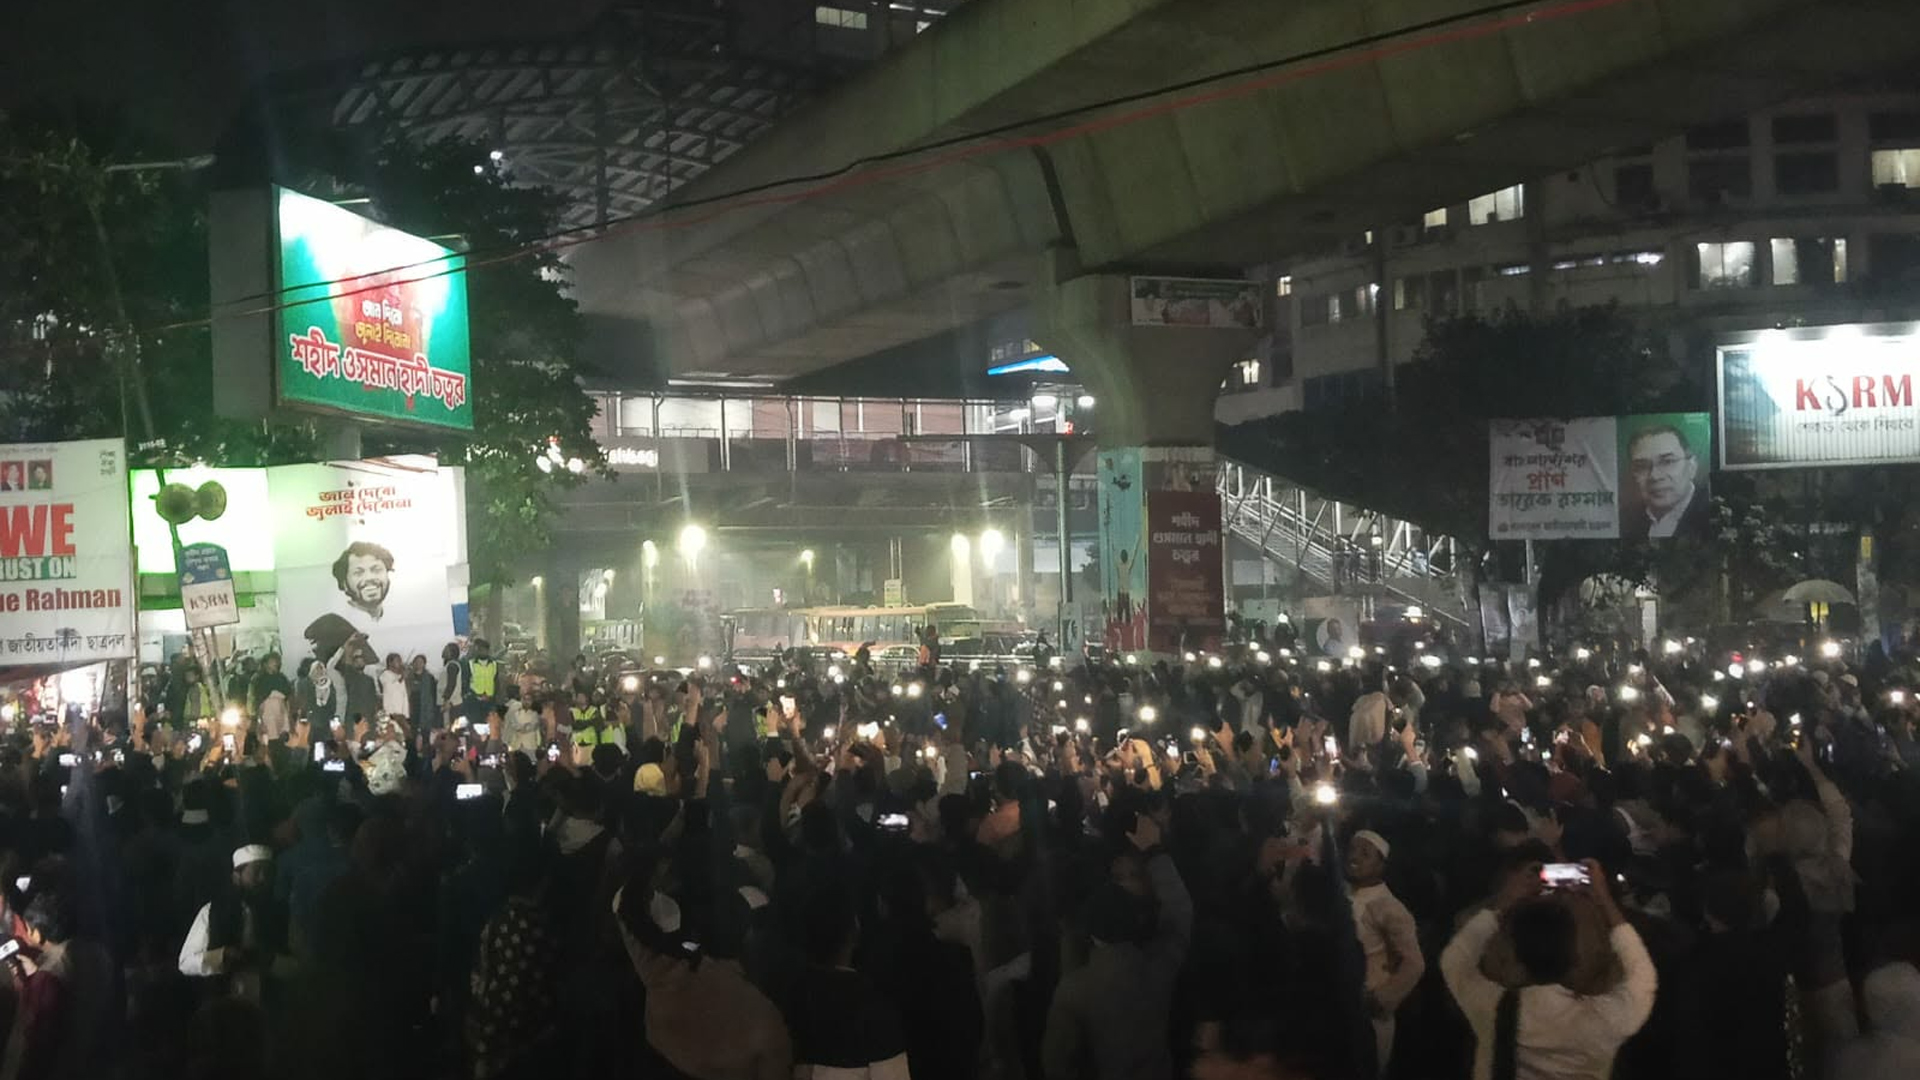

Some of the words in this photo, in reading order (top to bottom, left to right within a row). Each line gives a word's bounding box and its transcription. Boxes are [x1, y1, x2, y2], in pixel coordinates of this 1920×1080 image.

[289, 326, 341, 381] শহীদ
[342, 347, 398, 391] ওসমান
[398, 352, 431, 398] হাদী
[431, 368, 466, 411] চত্বর
[1796, 374, 1913, 417] KSRM
[318, 488, 356, 502] জান
[358, 486, 396, 502] দেবো
[306, 500, 355, 521] জুলাই
[0, 503, 76, 557] WE
[48, 556, 77, 579] ON
[26, 587, 122, 611] Rahman
[87, 634, 126, 651] ছাত্রদল
